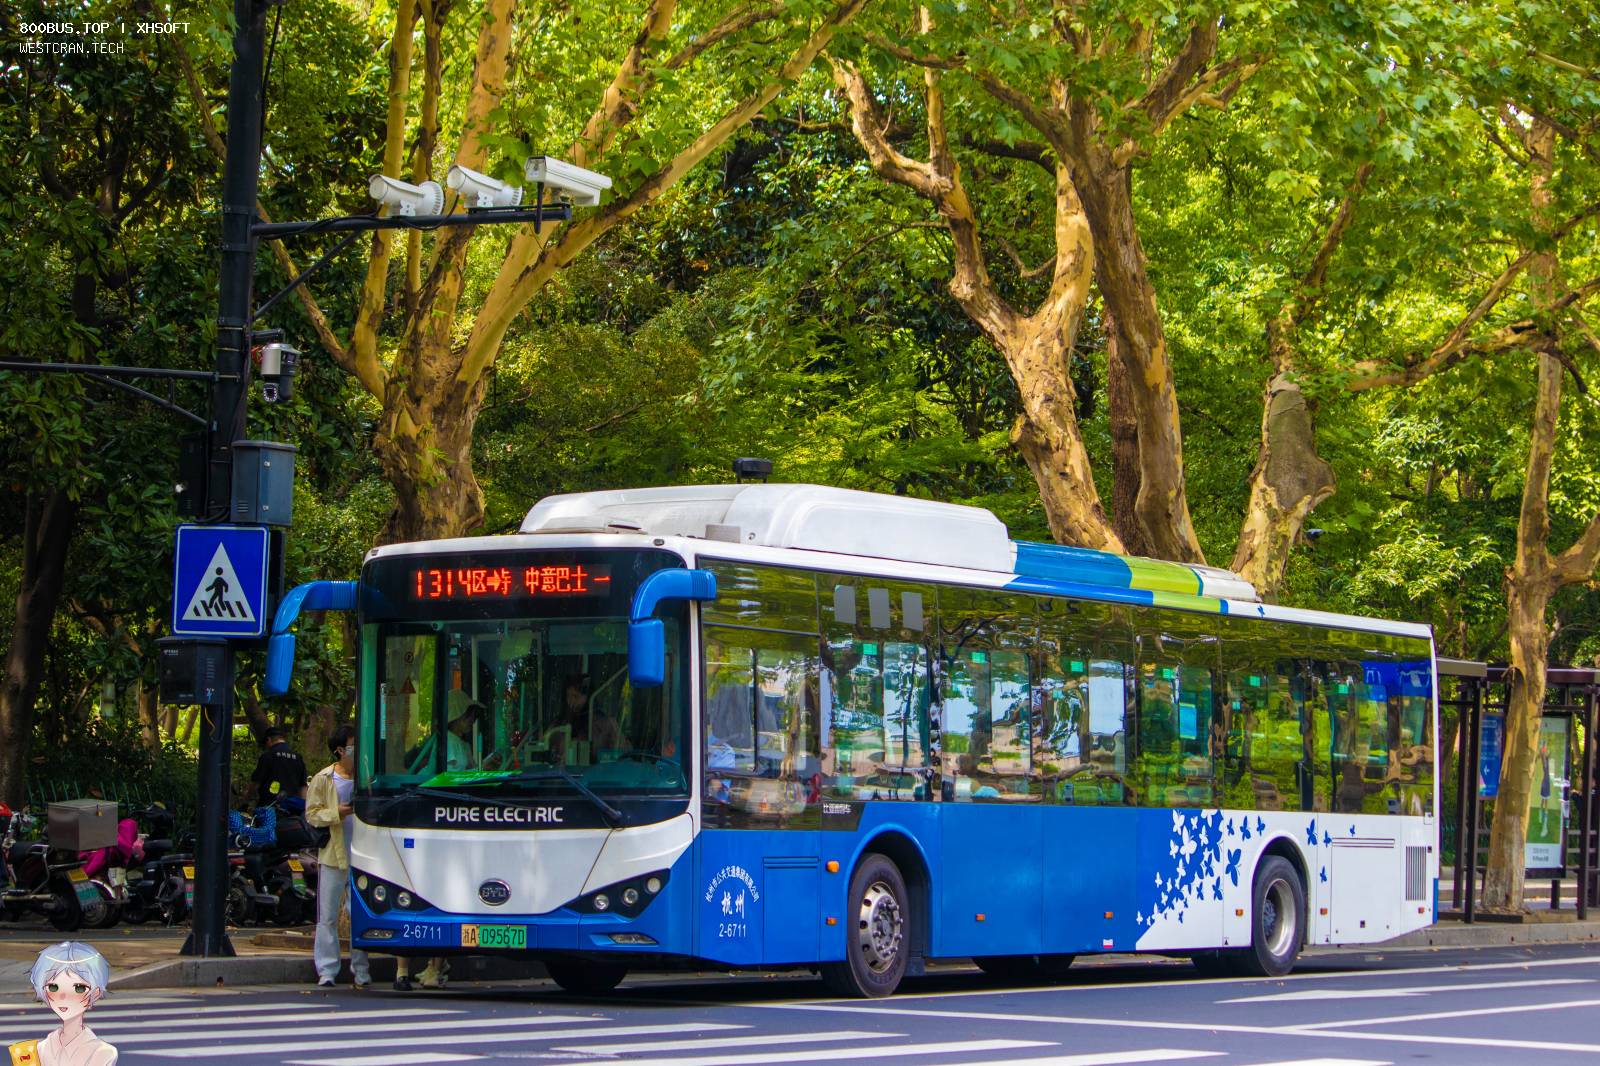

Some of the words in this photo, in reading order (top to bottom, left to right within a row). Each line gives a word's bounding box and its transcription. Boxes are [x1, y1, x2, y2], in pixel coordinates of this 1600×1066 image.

[434, 806, 480, 822] PURE
[483, 806, 563, 822] ELECTRIC
[403, 923, 442, 940] 2-6711
[718, 923, 746, 938] 2-6711
